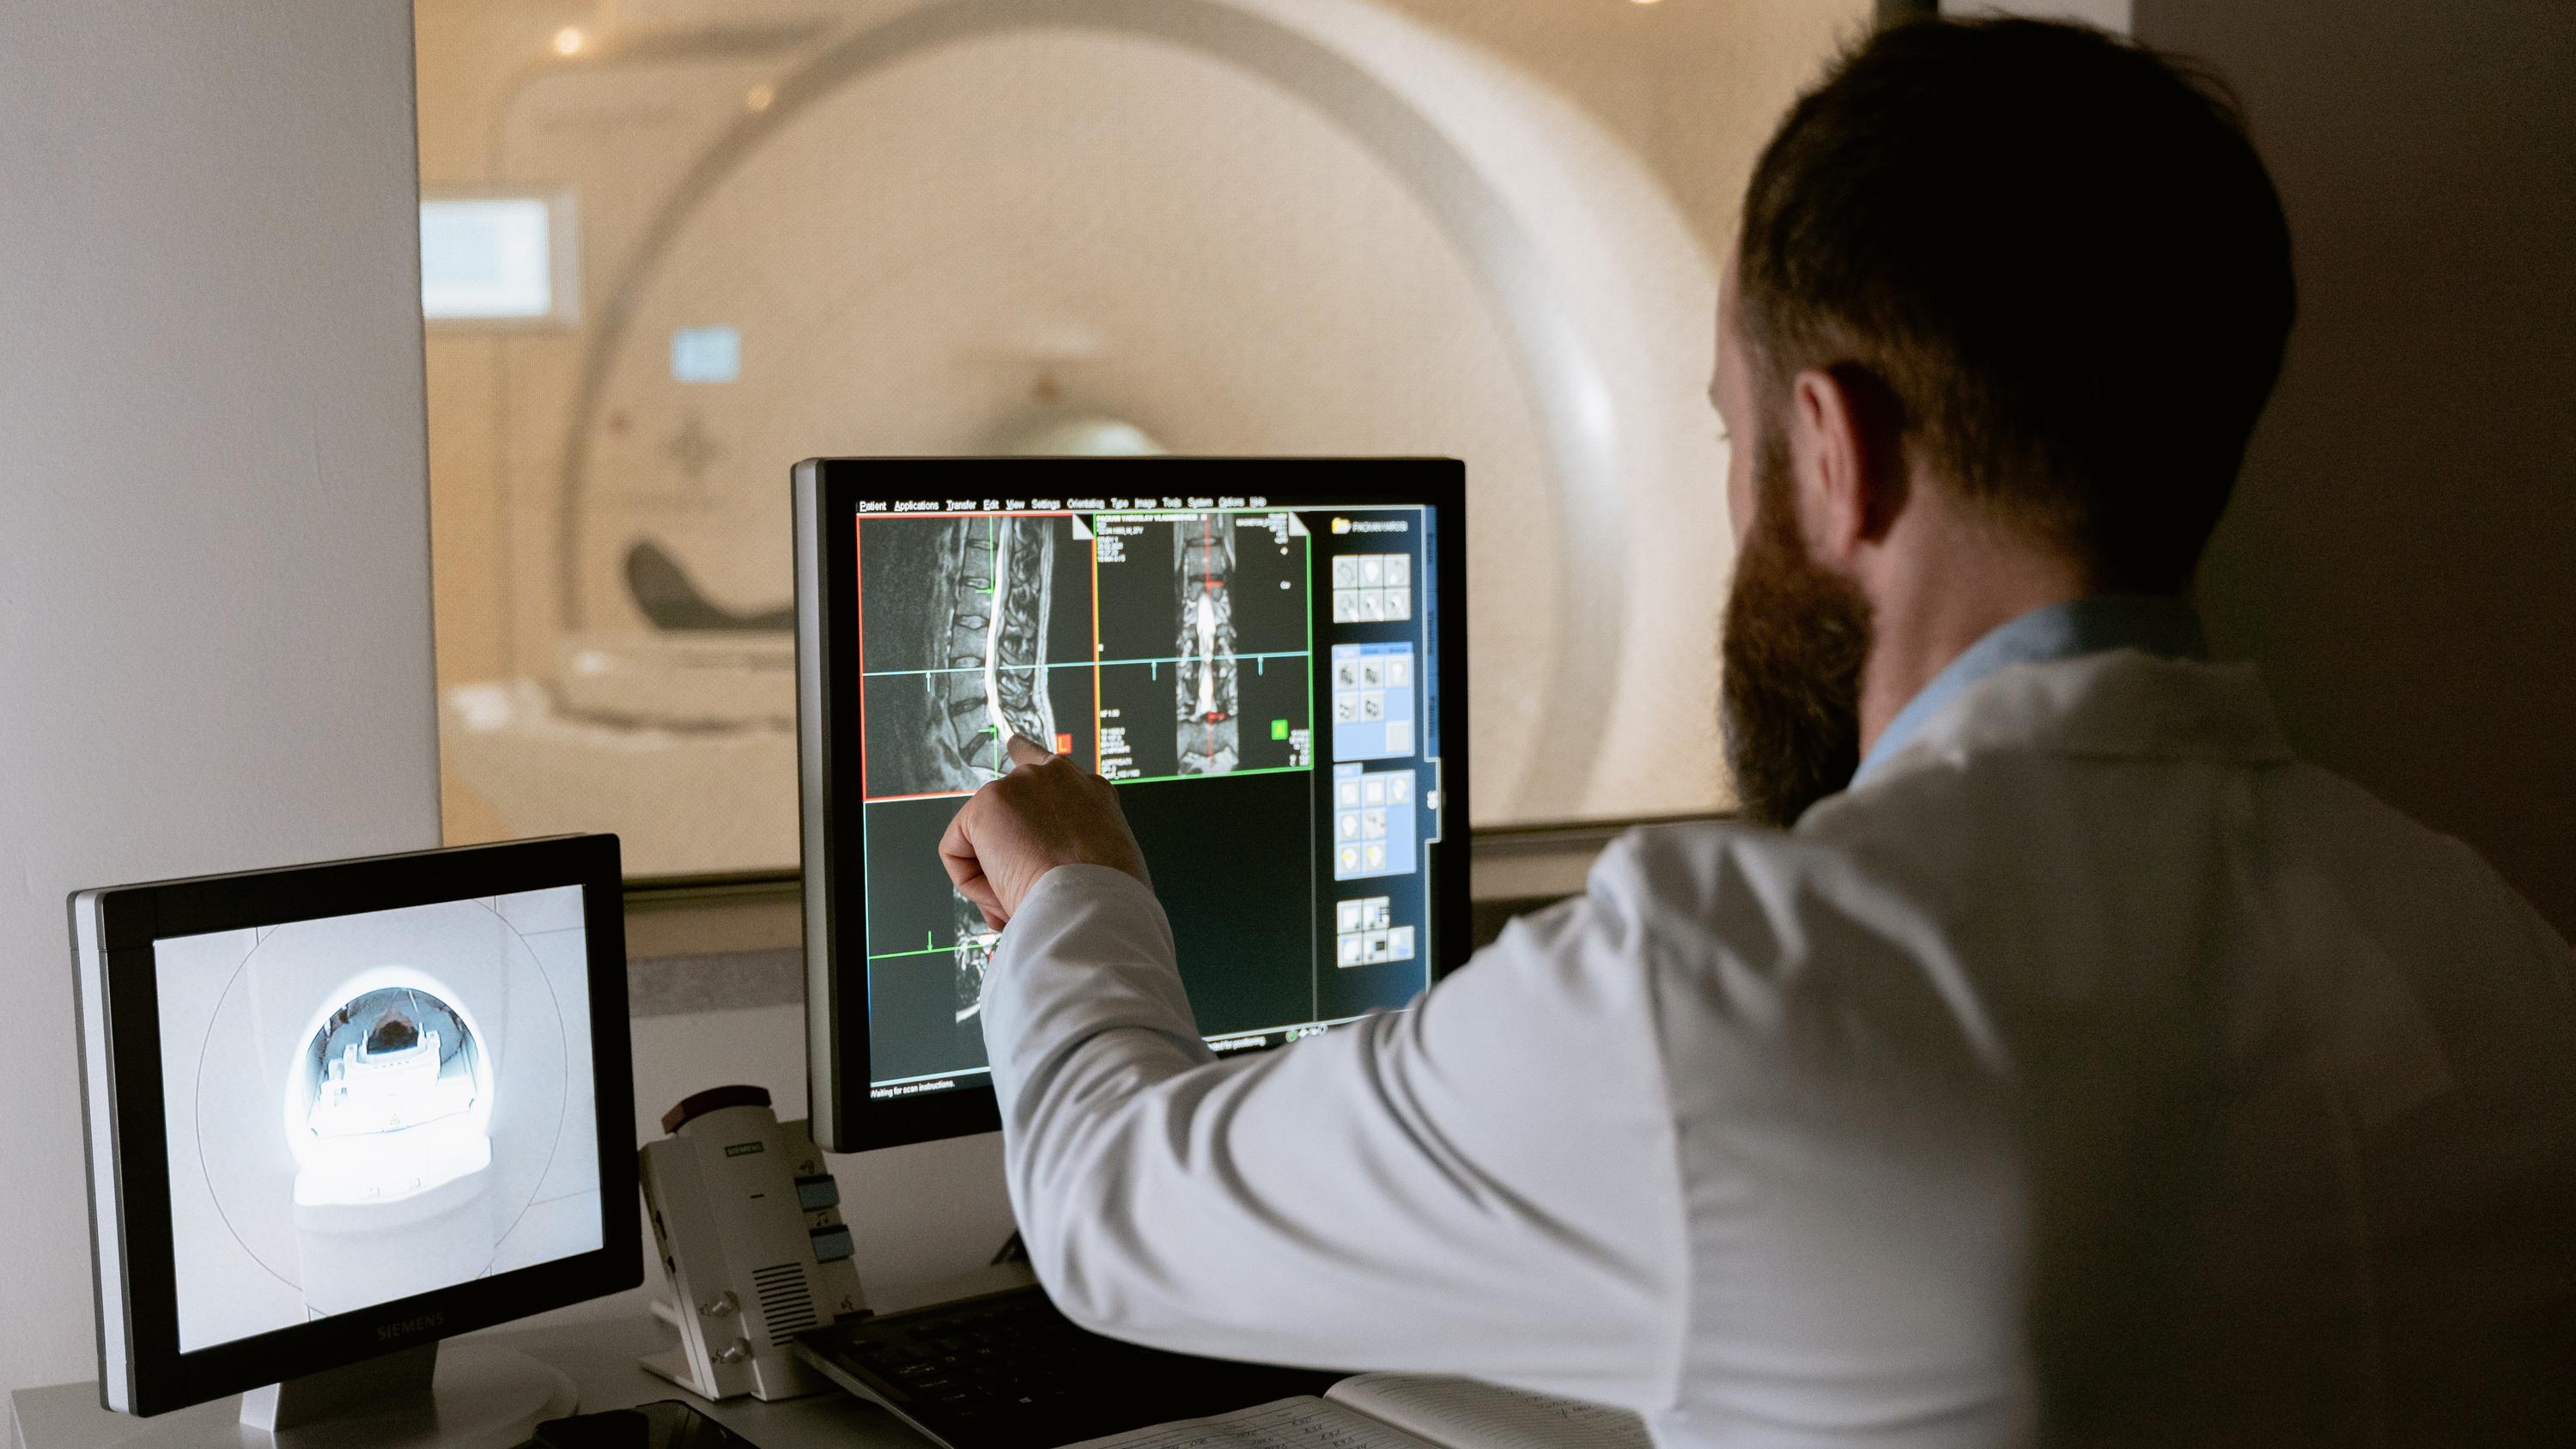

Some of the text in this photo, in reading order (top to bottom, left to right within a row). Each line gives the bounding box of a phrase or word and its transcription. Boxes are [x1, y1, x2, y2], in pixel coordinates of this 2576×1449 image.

[860, 496, 1267, 512] Patient Applications Transfer Edit View Settings Orientation Type Image Tools System Options Help
[1058, 735, 1068, 752] L
[871, 1089, 893, 1098] Waiting
[893, 1087, 902, 1095] for
[902, 1086, 918, 1094] scan
[377, 1312, 445, 1341] SIEMENS
